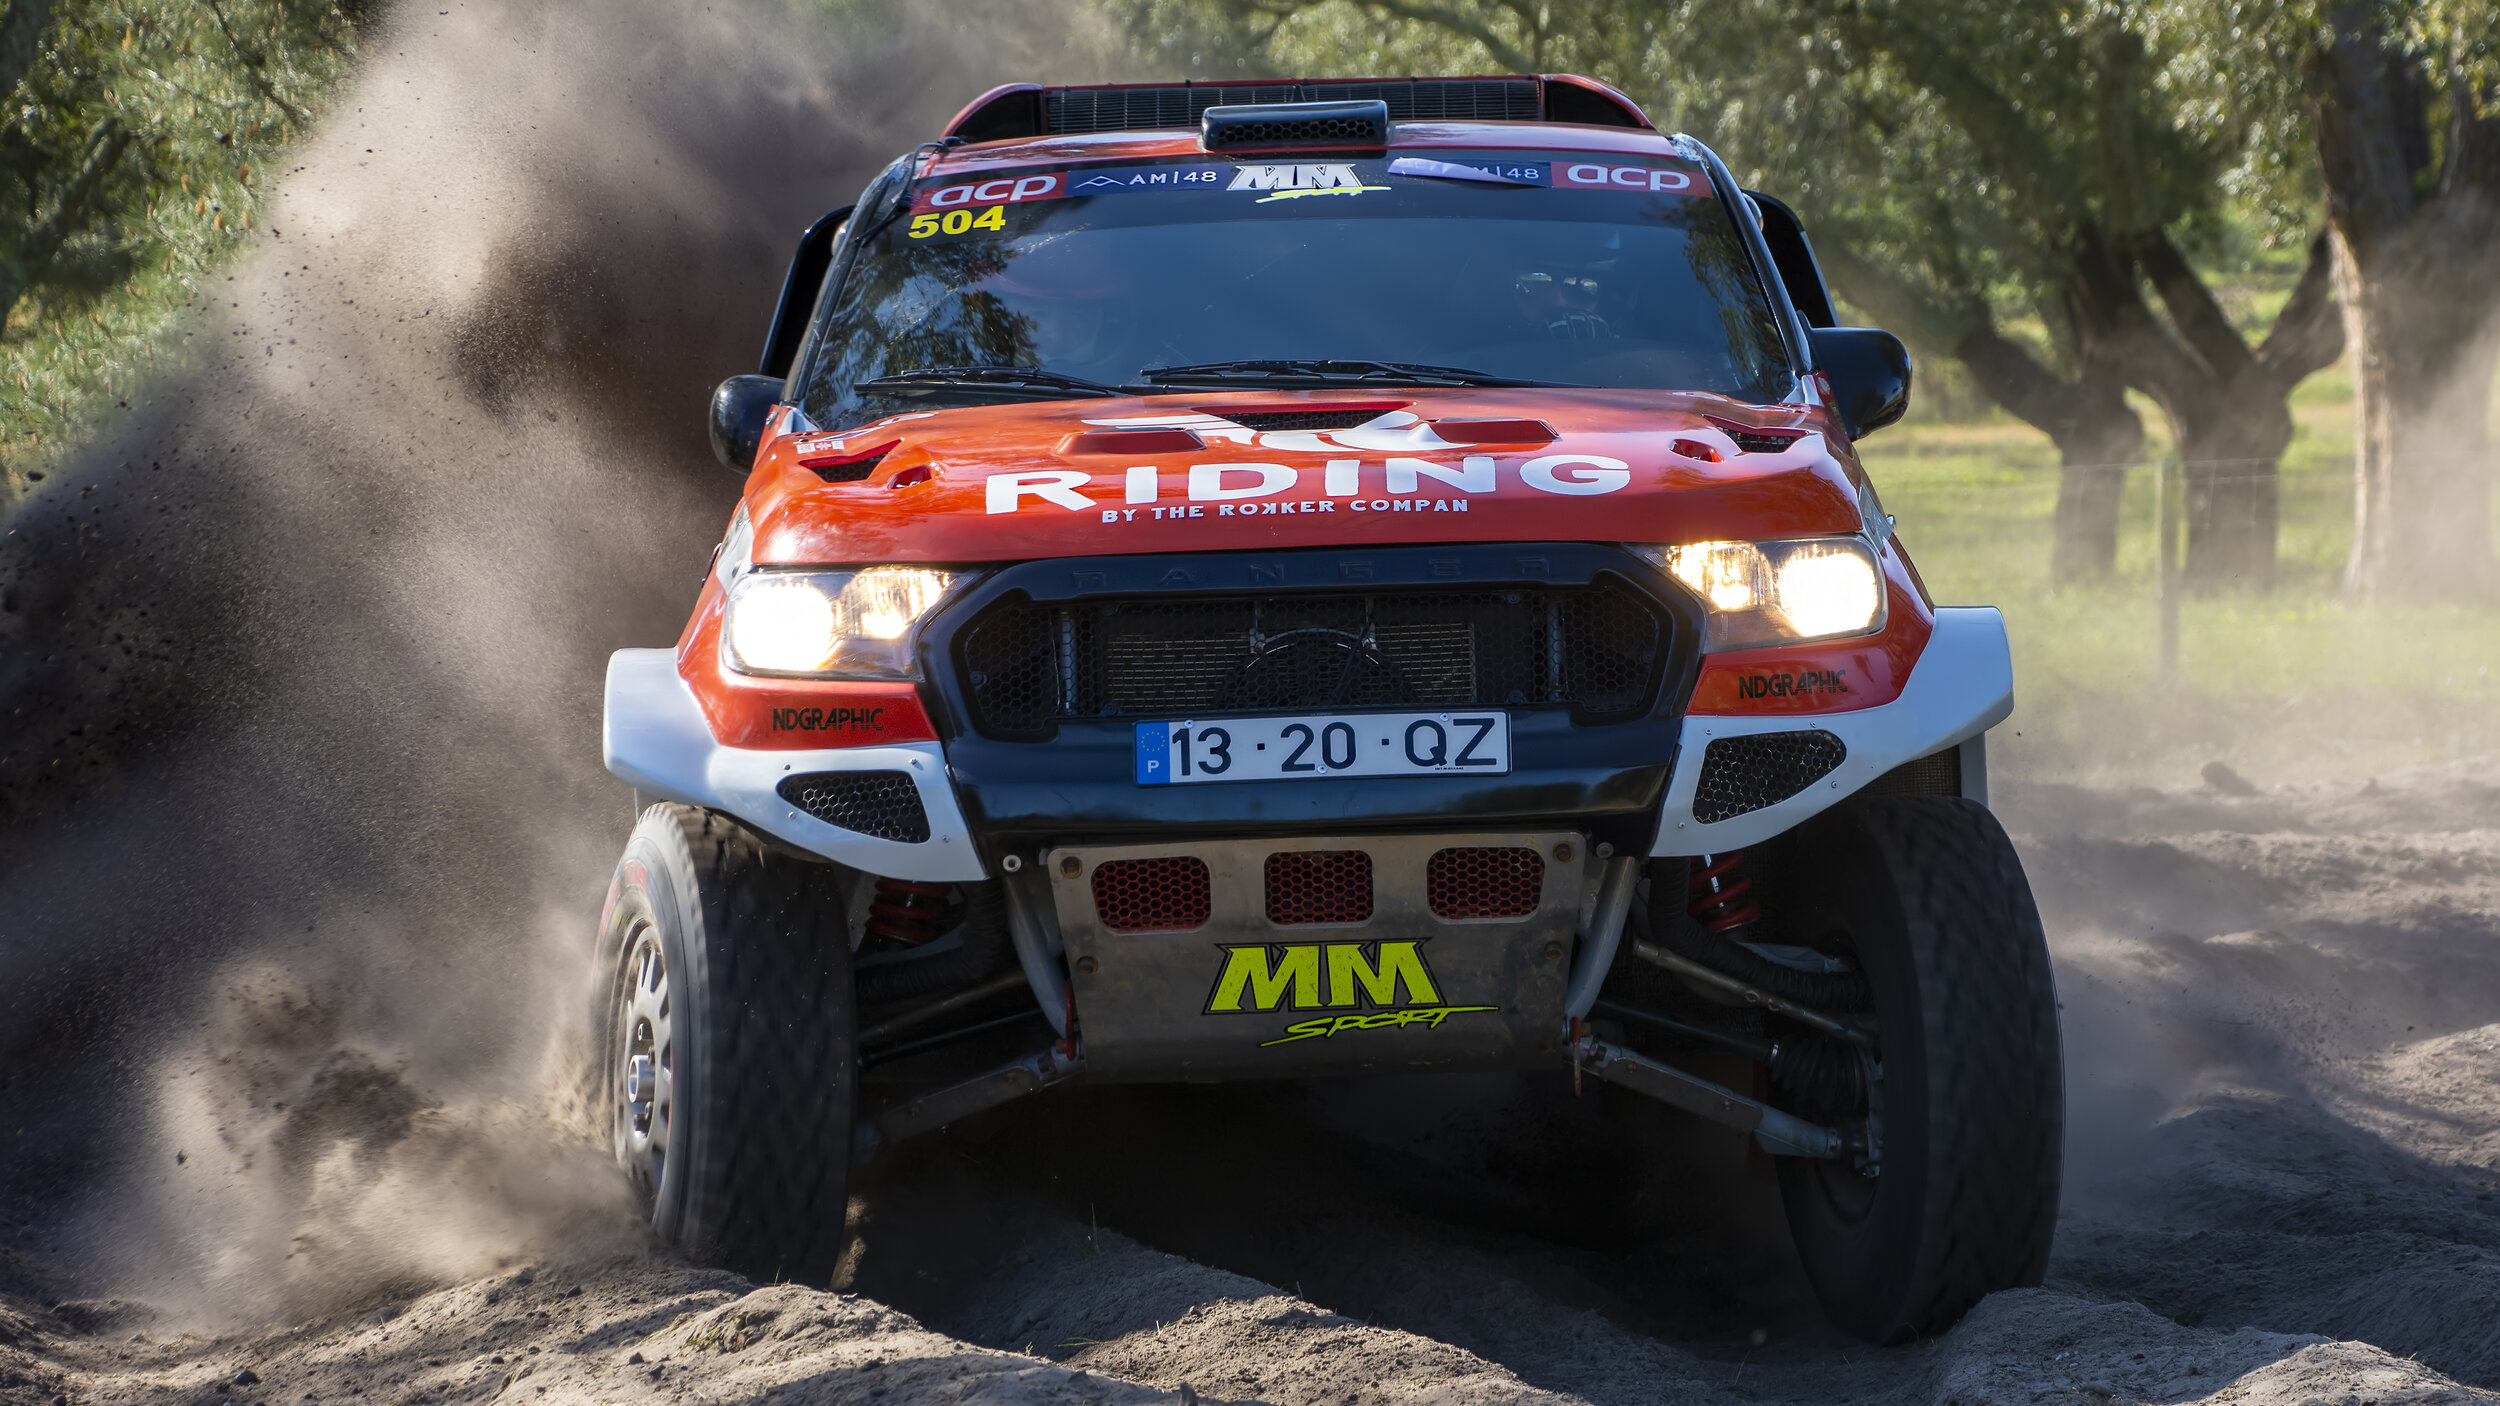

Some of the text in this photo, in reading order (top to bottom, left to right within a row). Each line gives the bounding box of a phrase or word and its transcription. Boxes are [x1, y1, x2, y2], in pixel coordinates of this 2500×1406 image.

[930, 175, 1057, 207] acp
[1227, 164, 1363, 191] MM
[1567, 164, 1690, 191] acp
[908, 205, 1006, 239] 504
[985, 454, 1631, 515] RIDING
[1102, 509, 1137, 523] BY
[1151, 505, 1204, 520] THE
[1350, 499, 1468, 513] COMPAN
[1739, 669, 1848, 699] NDGRAPHIC
[772, 707, 884, 731] NDGRAPHIC
[1147, 760, 1160, 773] P
[1204, 938, 1447, 1014] MM
[1258, 1005, 1500, 1047] SPORT
